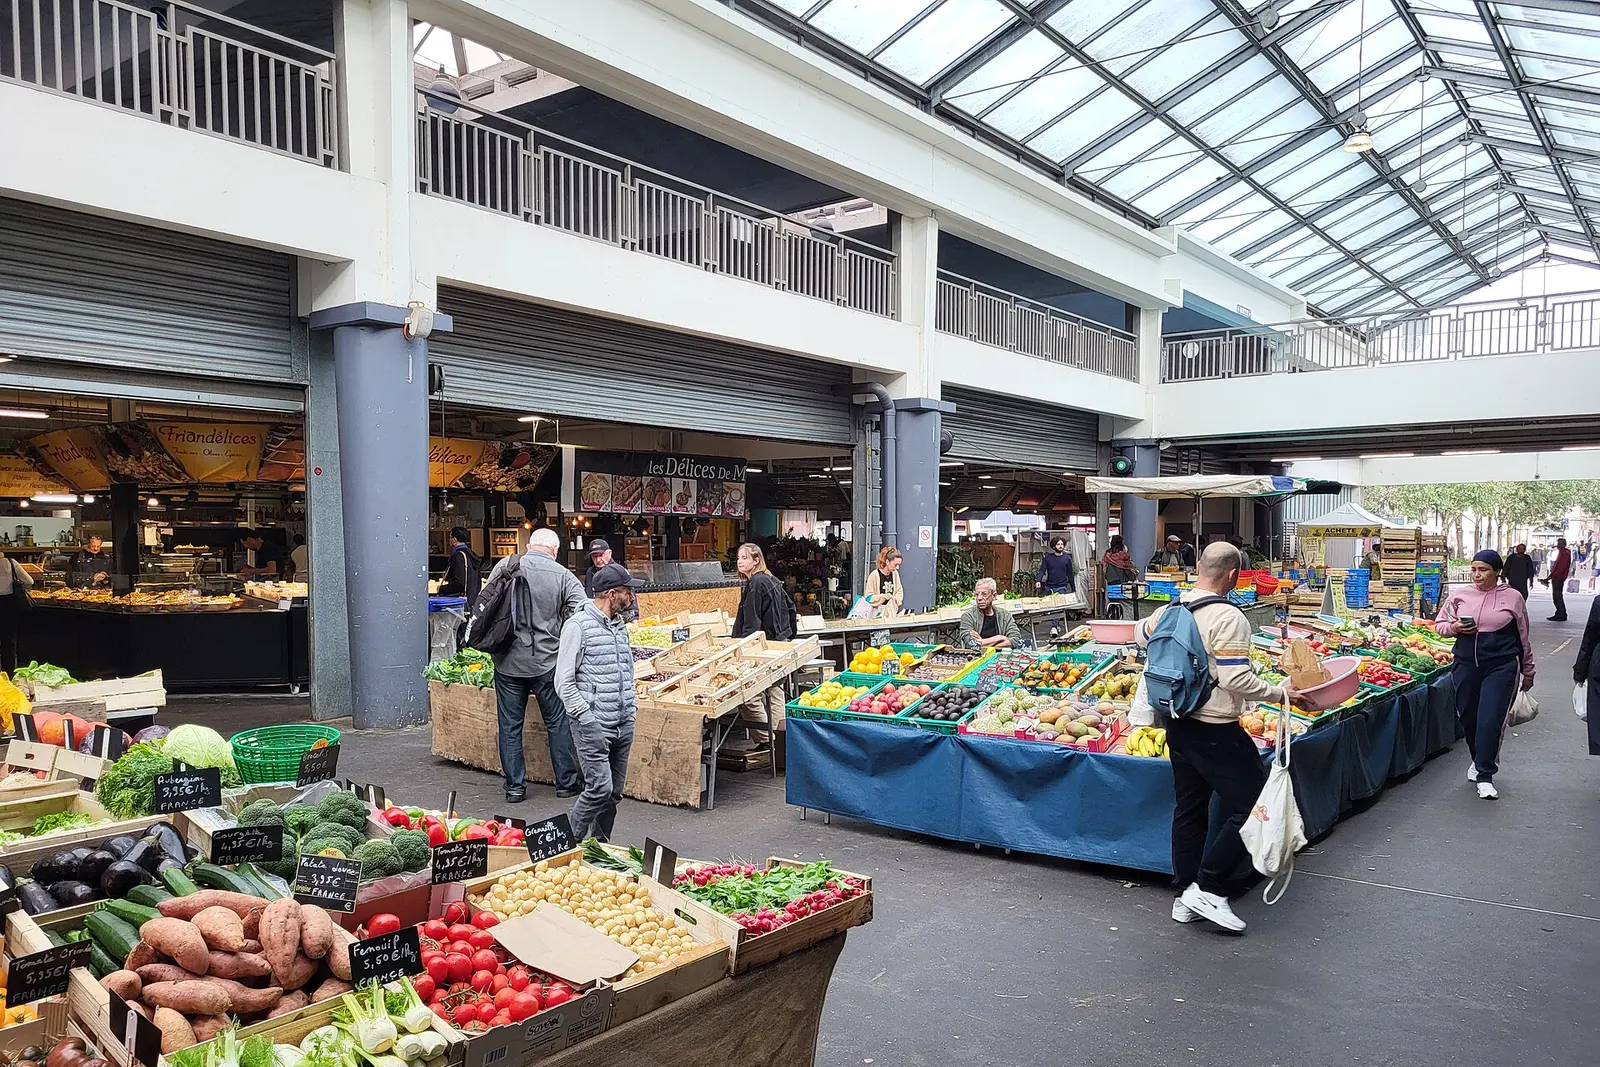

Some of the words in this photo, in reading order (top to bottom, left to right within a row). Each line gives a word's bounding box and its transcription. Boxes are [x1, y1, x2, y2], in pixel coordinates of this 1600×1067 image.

[159, 425, 257, 446] Friandélices
[664, 457, 716, 480] Délices
[160, 797, 204, 811] FRANCE
[218, 853, 264, 864] FRANCE
[311, 873, 342, 888] 3,95€
[435, 869, 474, 883] FRANCE
[311, 887, 347, 900] FRANCE
[12, 980, 68, 1003] FRANCE
